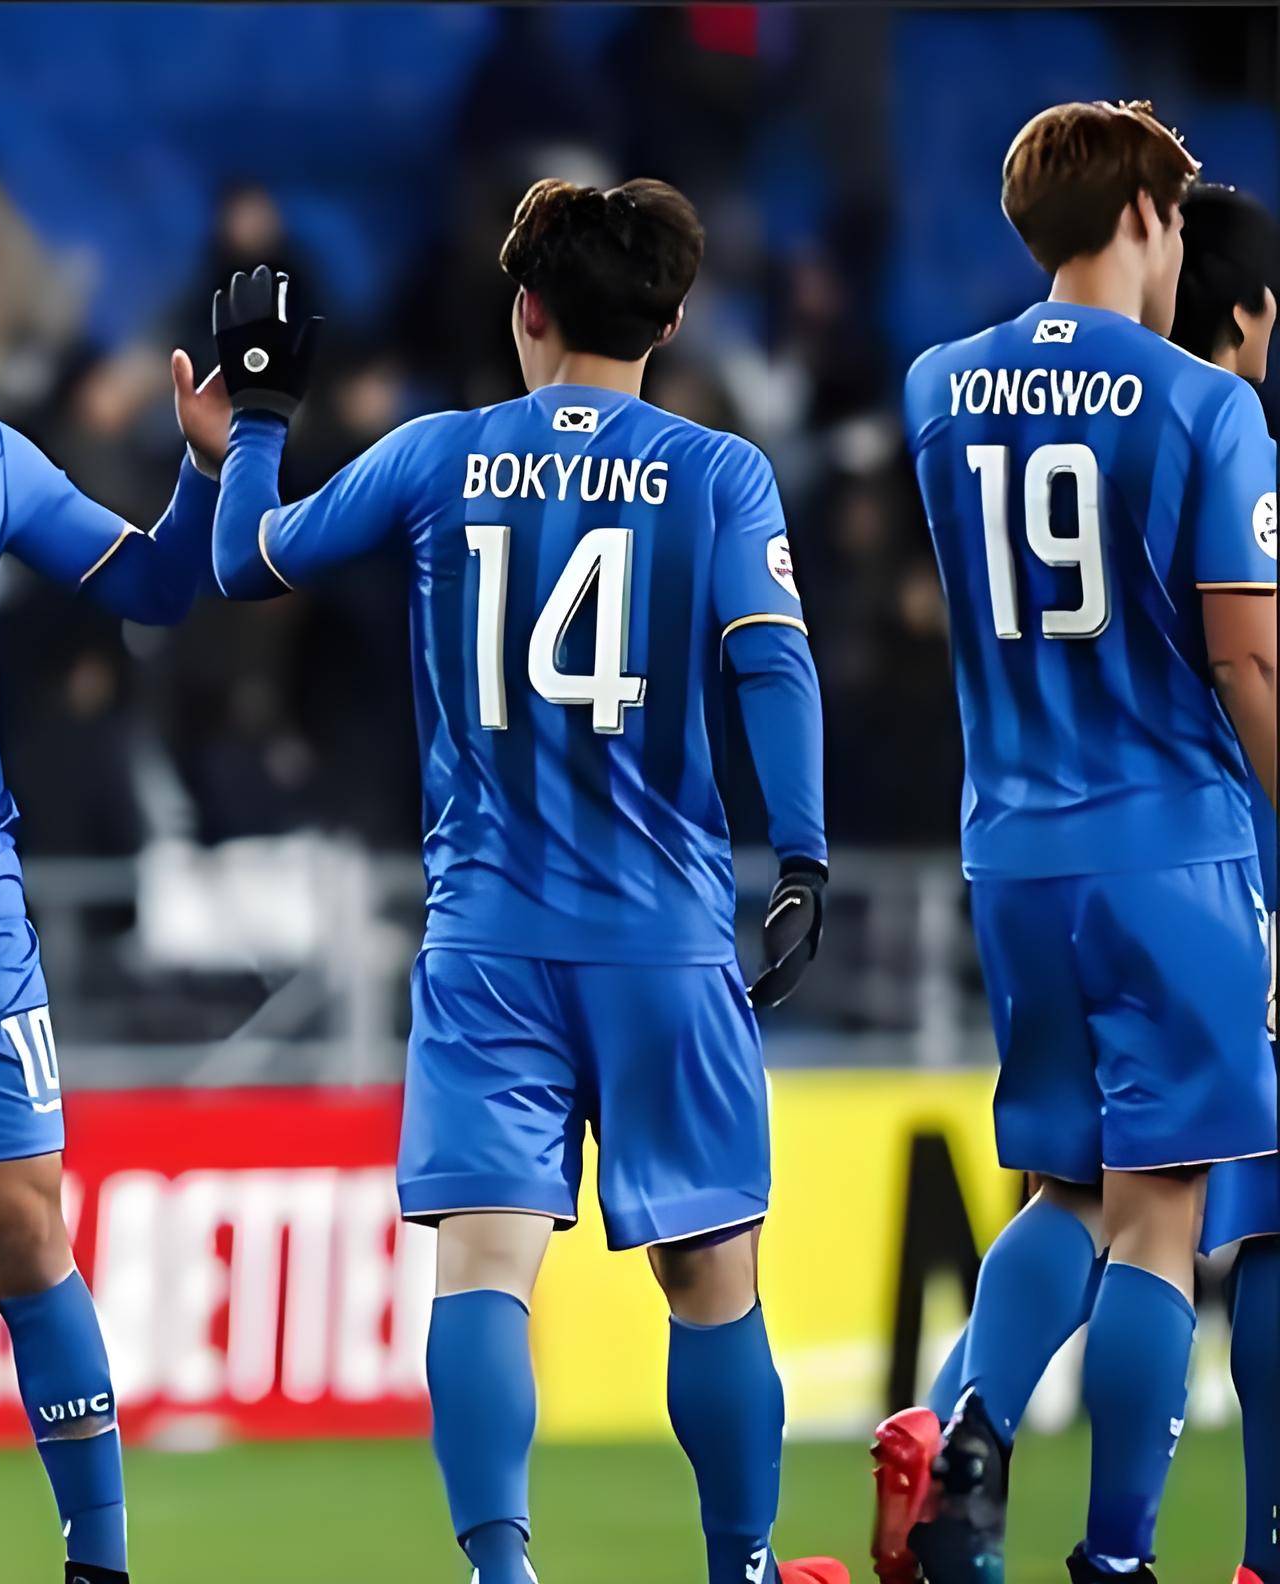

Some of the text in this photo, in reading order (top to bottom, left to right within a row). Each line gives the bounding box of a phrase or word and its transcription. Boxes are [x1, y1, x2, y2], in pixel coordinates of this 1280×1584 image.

[949, 368, 1143, 417] YONGWOO
[463, 453, 669, 505] BOKYUNG
[966, 443, 1111, 639] 19
[465, 525, 646, 734] 14
[0, 1005, 61, 1100] 10
